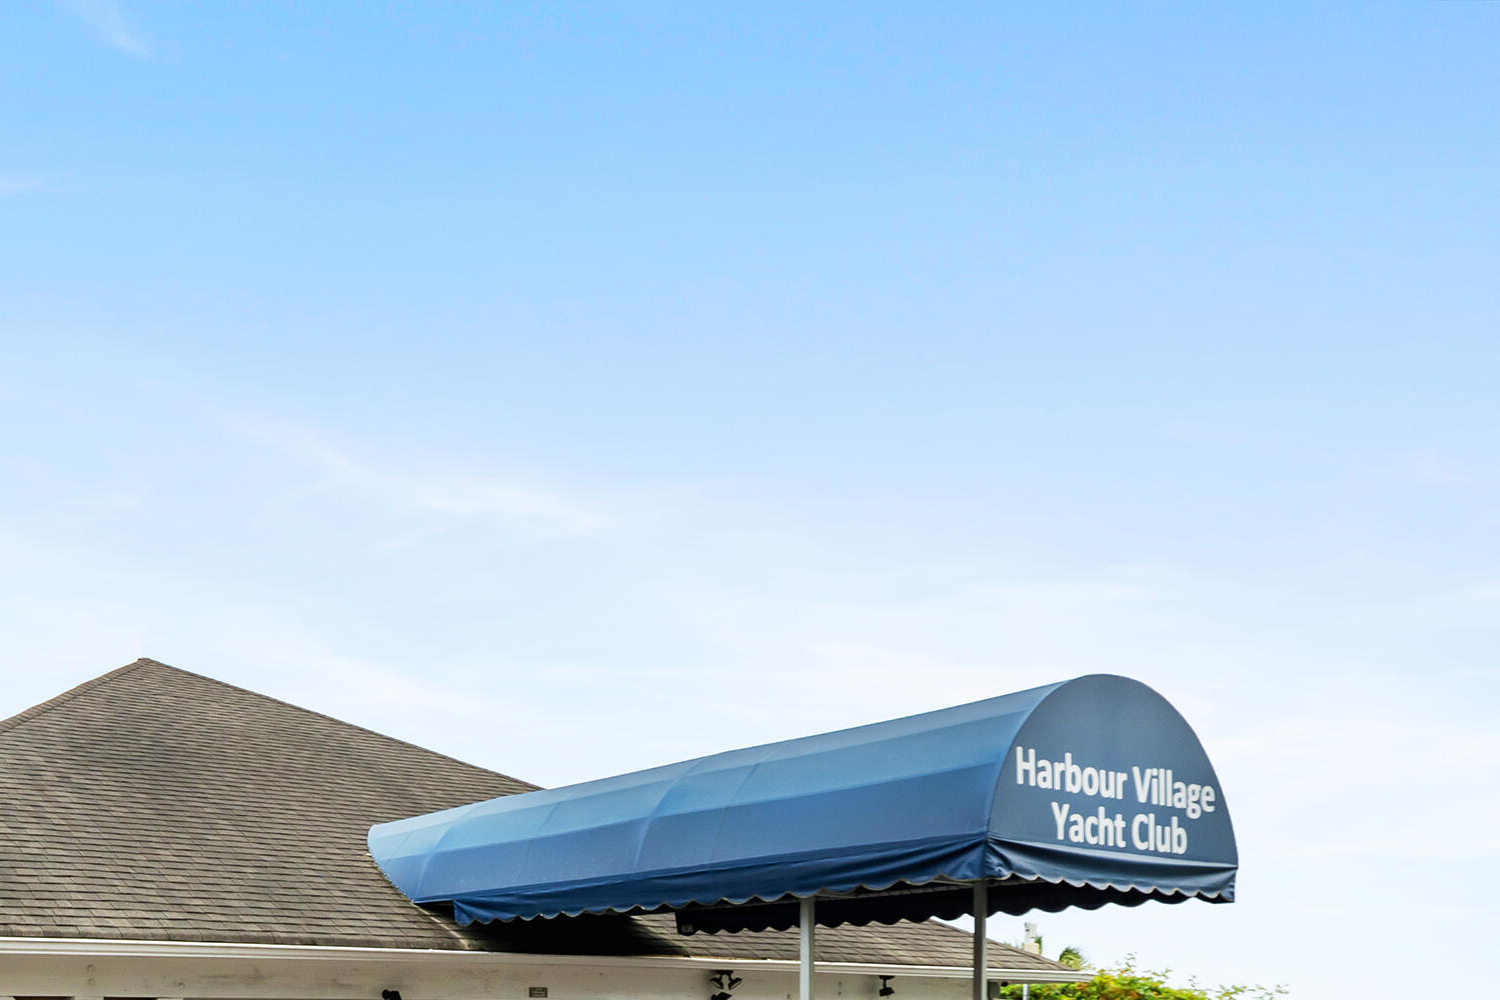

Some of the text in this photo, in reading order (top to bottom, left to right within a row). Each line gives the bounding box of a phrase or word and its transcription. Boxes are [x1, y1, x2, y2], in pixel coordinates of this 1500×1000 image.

[1015, 746, 1216, 820] Harbour Village
[1051, 802, 1188, 855] Yacht Club
